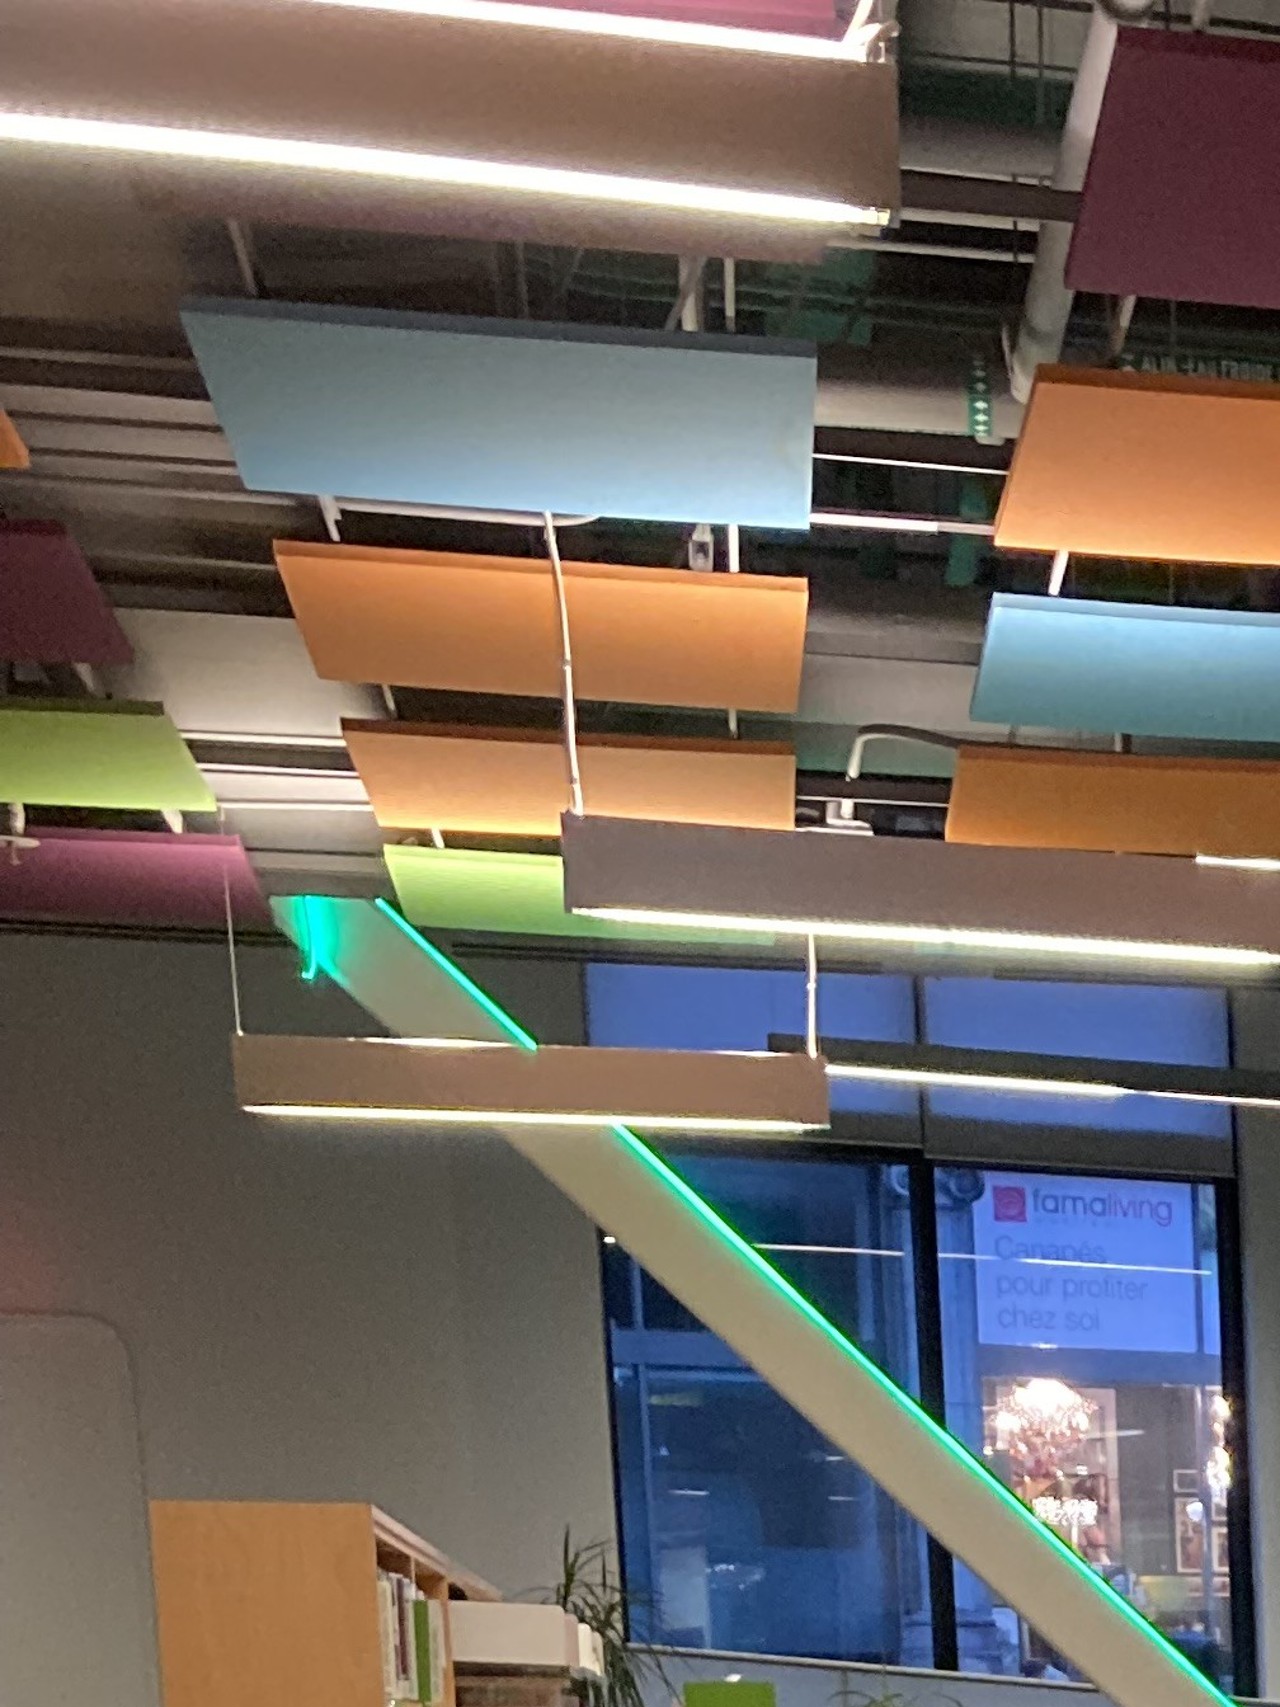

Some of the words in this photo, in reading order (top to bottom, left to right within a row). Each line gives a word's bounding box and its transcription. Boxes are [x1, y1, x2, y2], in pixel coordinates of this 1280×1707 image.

[1032, 1188, 1173, 1227] famaliving
[996, 1275, 1051, 1300] pour
[997, 1303, 1057, 1331] chez
